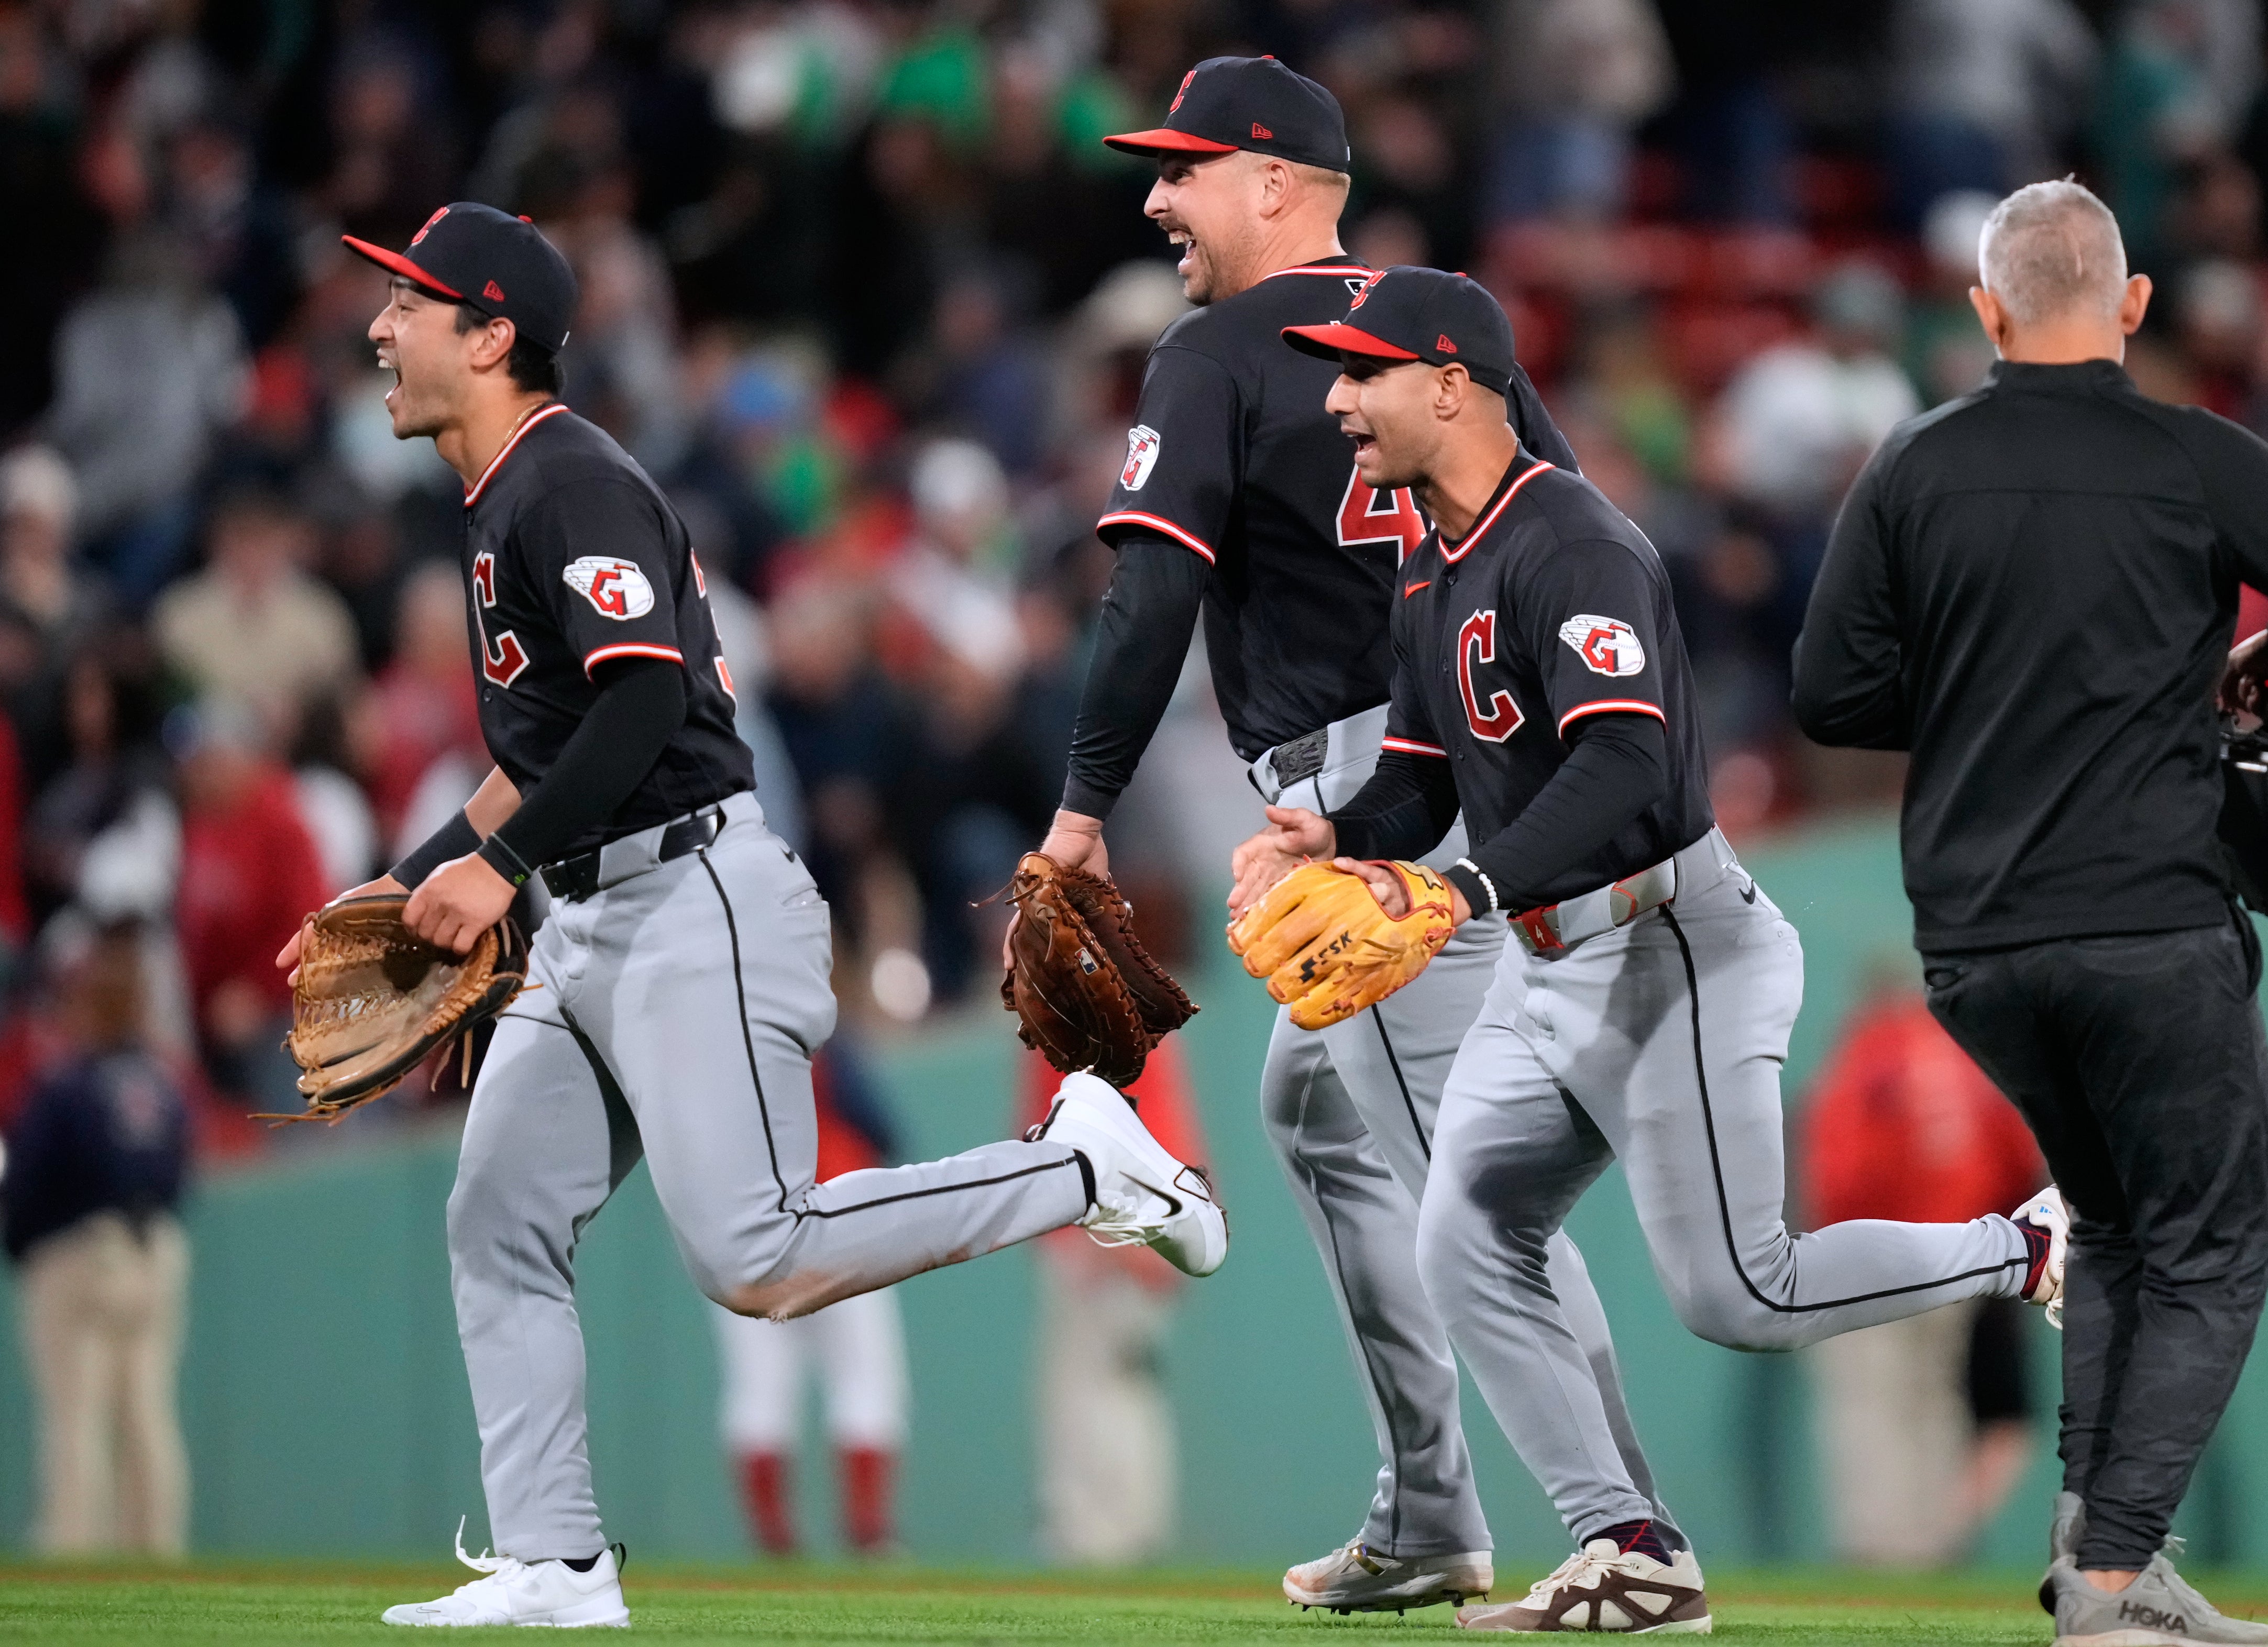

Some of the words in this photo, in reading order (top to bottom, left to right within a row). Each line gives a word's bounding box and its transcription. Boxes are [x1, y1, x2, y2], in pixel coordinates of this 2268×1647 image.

[1335, 462, 1436, 571] 4
[472, 550, 531, 689] C
[590, 568, 629, 616] G
[1458, 609, 1525, 743] C
[1582, 626, 1619, 673] G
[2119, 1600, 2188, 1634] HOKA
